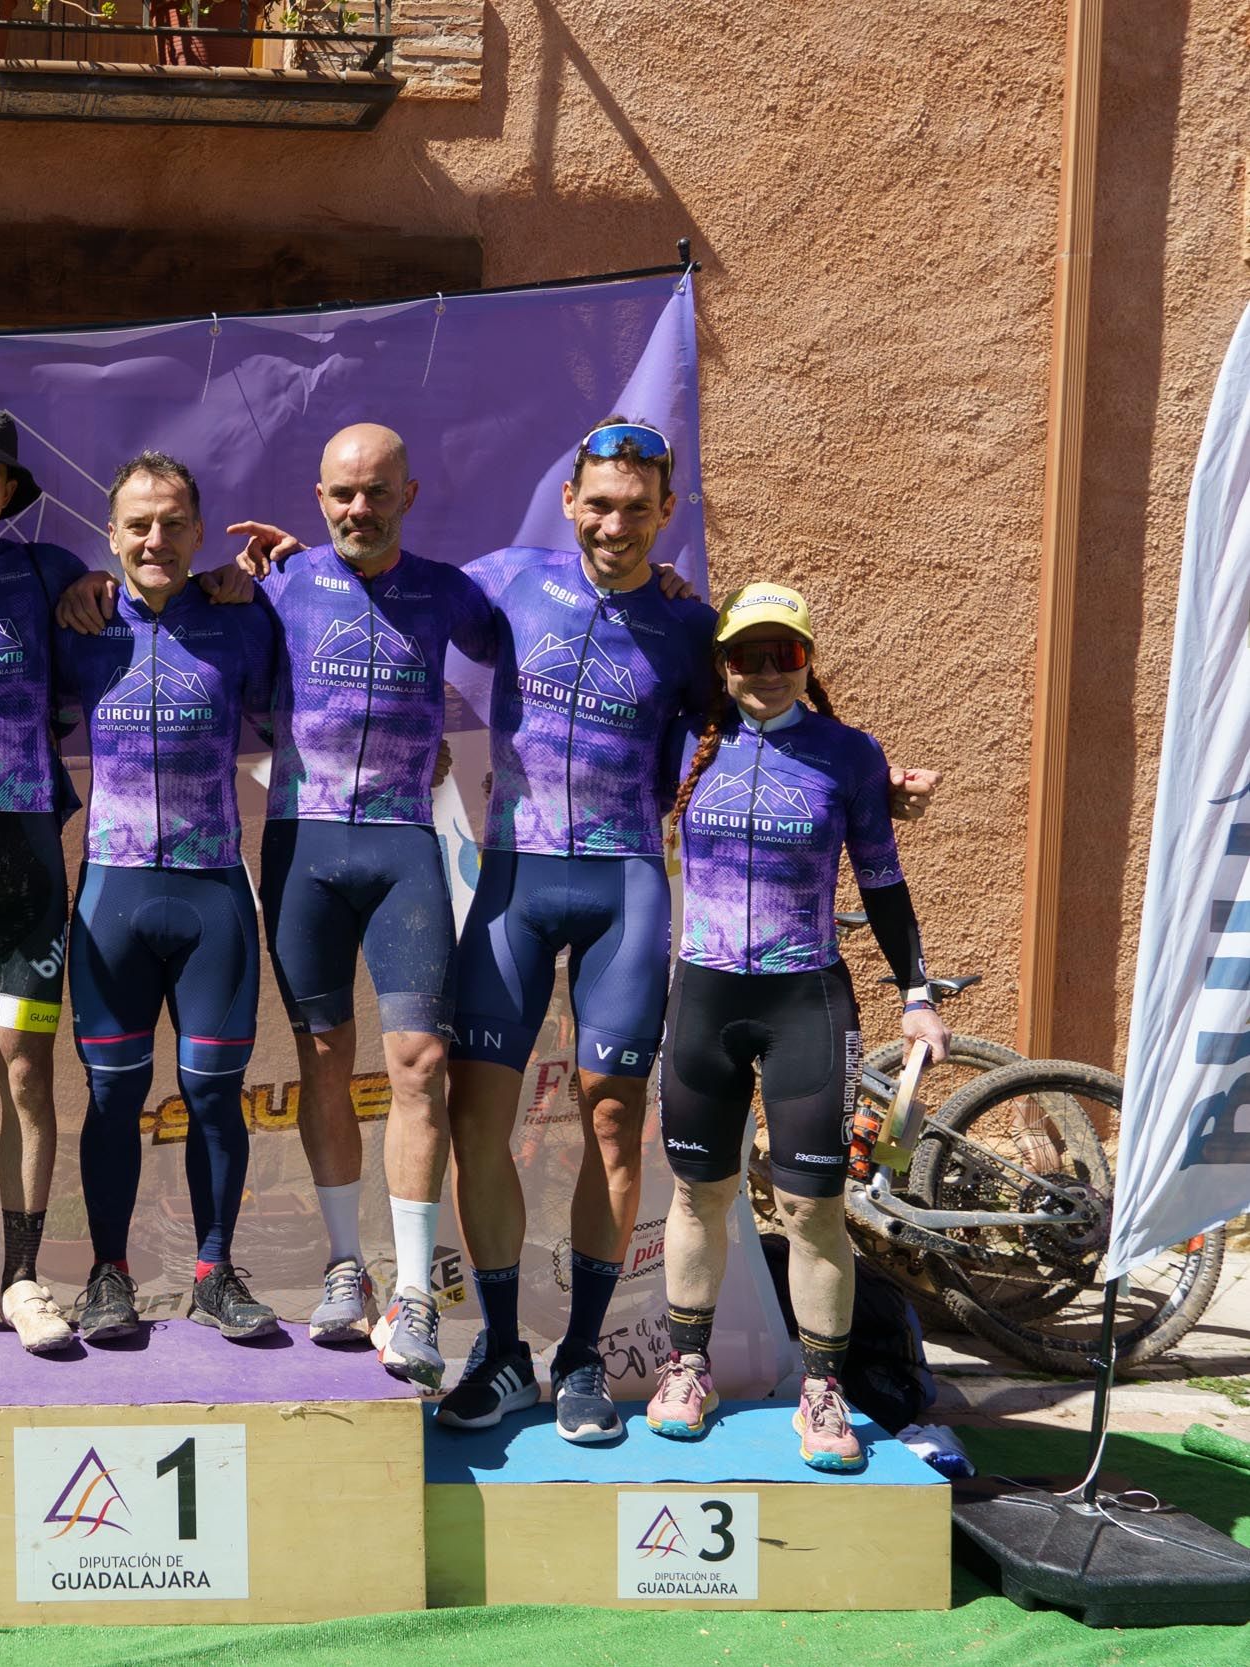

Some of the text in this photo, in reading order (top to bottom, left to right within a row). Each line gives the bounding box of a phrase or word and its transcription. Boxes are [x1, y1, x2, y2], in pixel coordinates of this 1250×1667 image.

[314, 575, 350, 591] GOBIK
[542, 580, 579, 605] GOBIK
[311, 661, 426, 683] CIRCUITO MTB
[372, 683, 426, 694] GUADALAJARA
[517, 675, 637, 719] CIRCUITO MTB
[97, 708, 212, 721] CIRCUITO MTB
[558, 706, 569, 715] DE
[575, 711, 634, 730] GUADALAJARA
[156, 725, 213, 733] GUADALAJARA
[691, 811, 813, 834] CIRCUITO MTB
[737, 832, 748, 840] DE
[752, 834, 812, 845] GUADALAJARA
[667, 1138, 709, 1153] Spiuk
[632, 1236, 665, 1272] piñ
[156, 1437, 197, 1540] 1
[698, 1500, 735, 1562] 3
[79, 1552, 184, 1569] DIPUTACIÓN DE
[51, 1570, 211, 1590] GUADALAJARA
[654, 1571, 721, 1581] DIPUTACIÓN DE
[637, 1582, 738, 1594] GUADALAJARA
